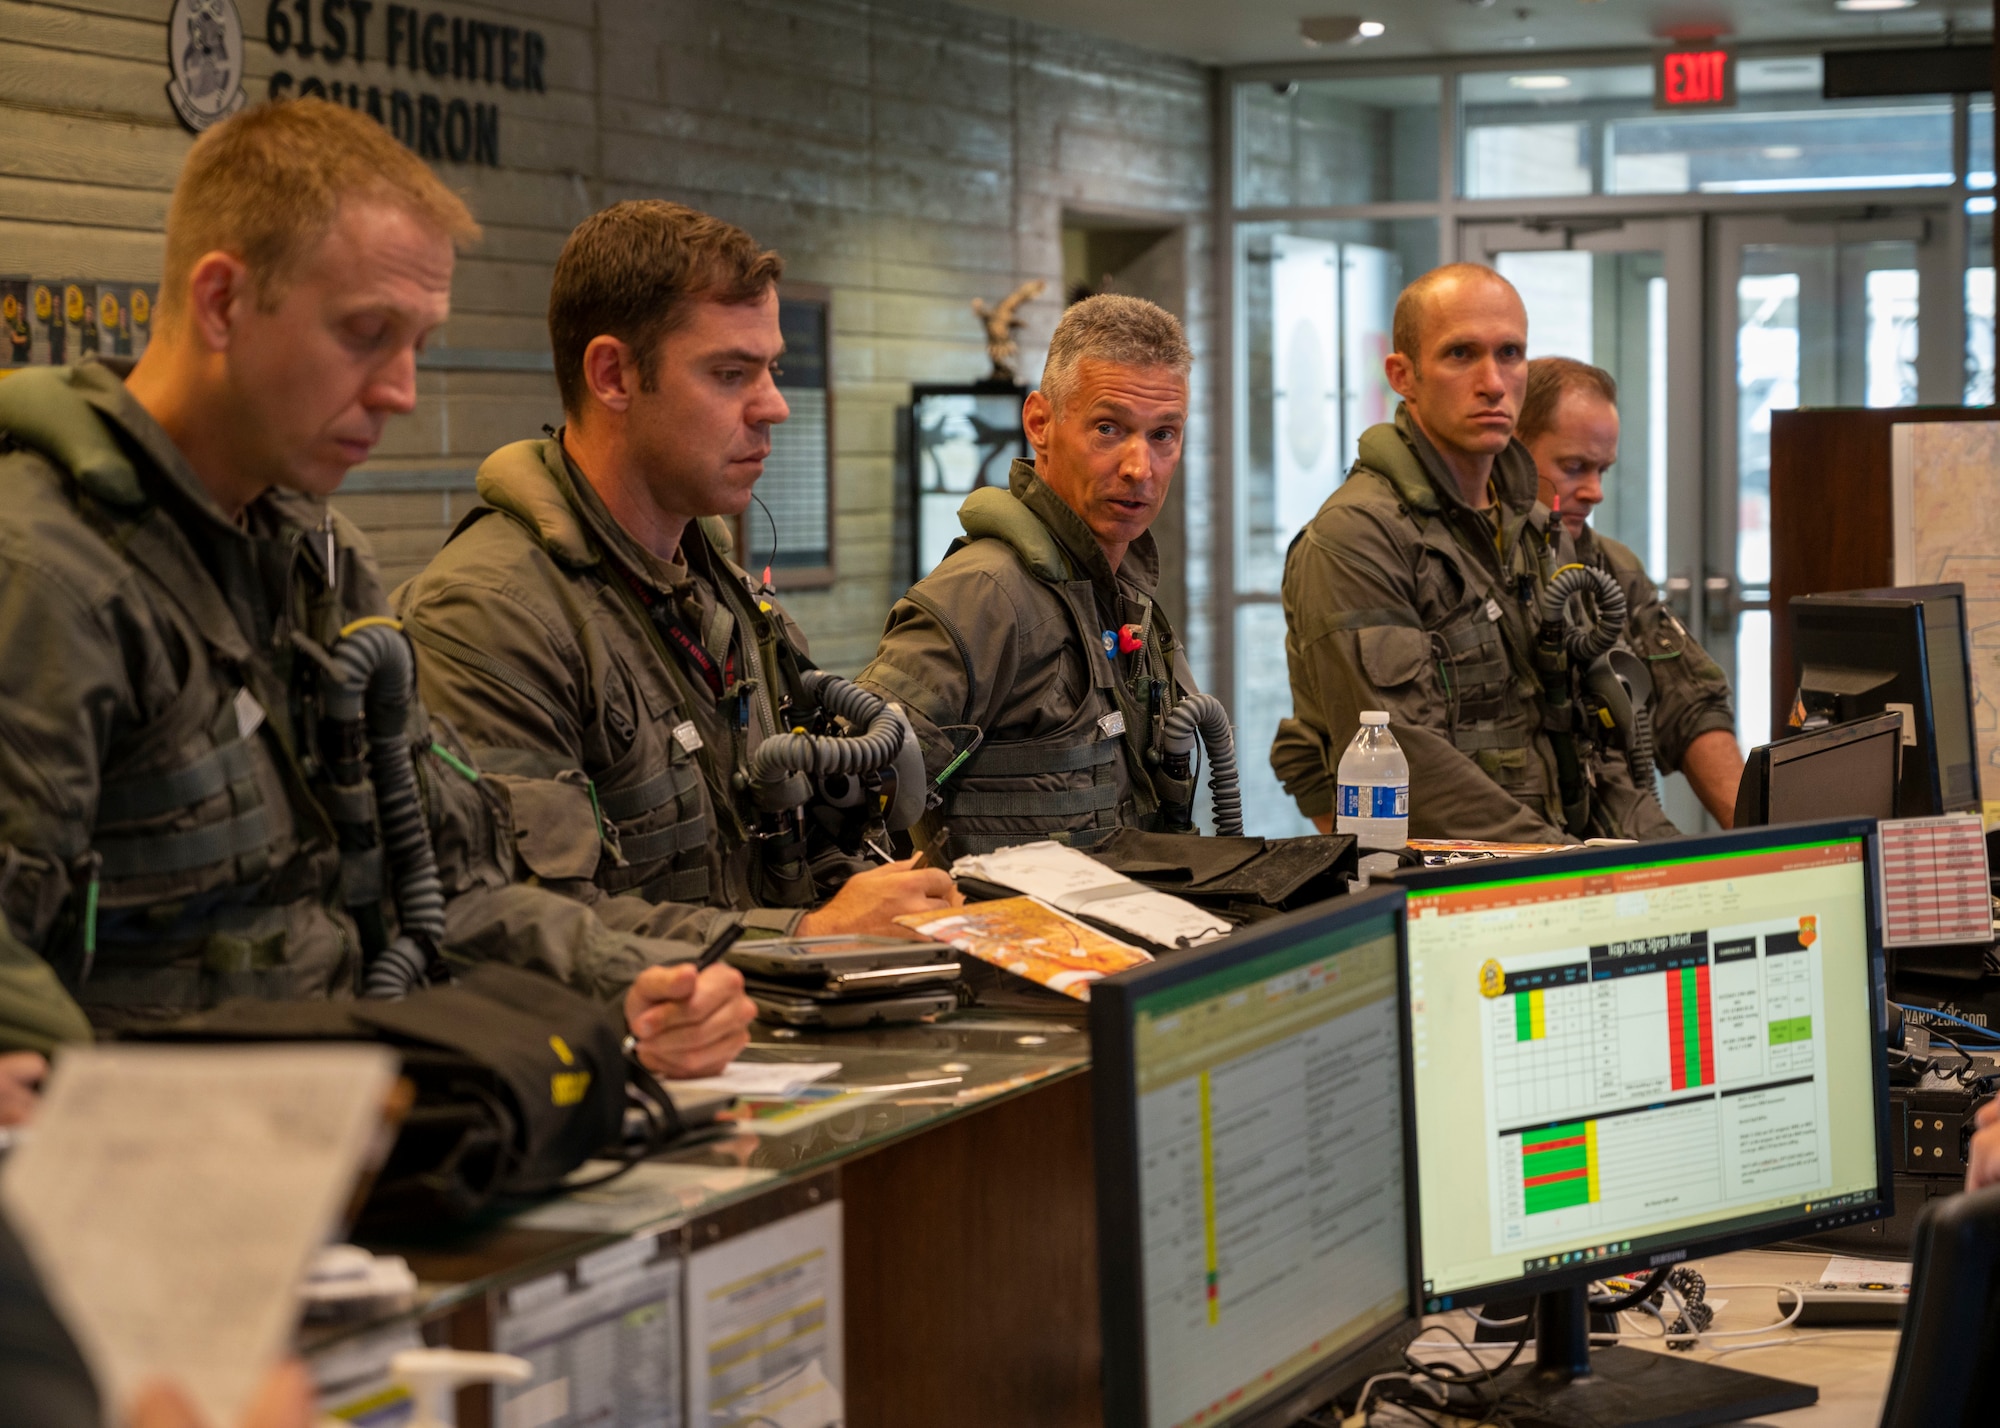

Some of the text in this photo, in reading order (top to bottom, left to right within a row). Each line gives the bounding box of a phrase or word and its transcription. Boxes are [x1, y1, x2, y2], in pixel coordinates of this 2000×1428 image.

[267, 0, 546, 94] 61ST FIGHTER
[1664, 50, 1727, 103] EXIT
[1650, 1248, 1687, 1267] SAMSUNG
